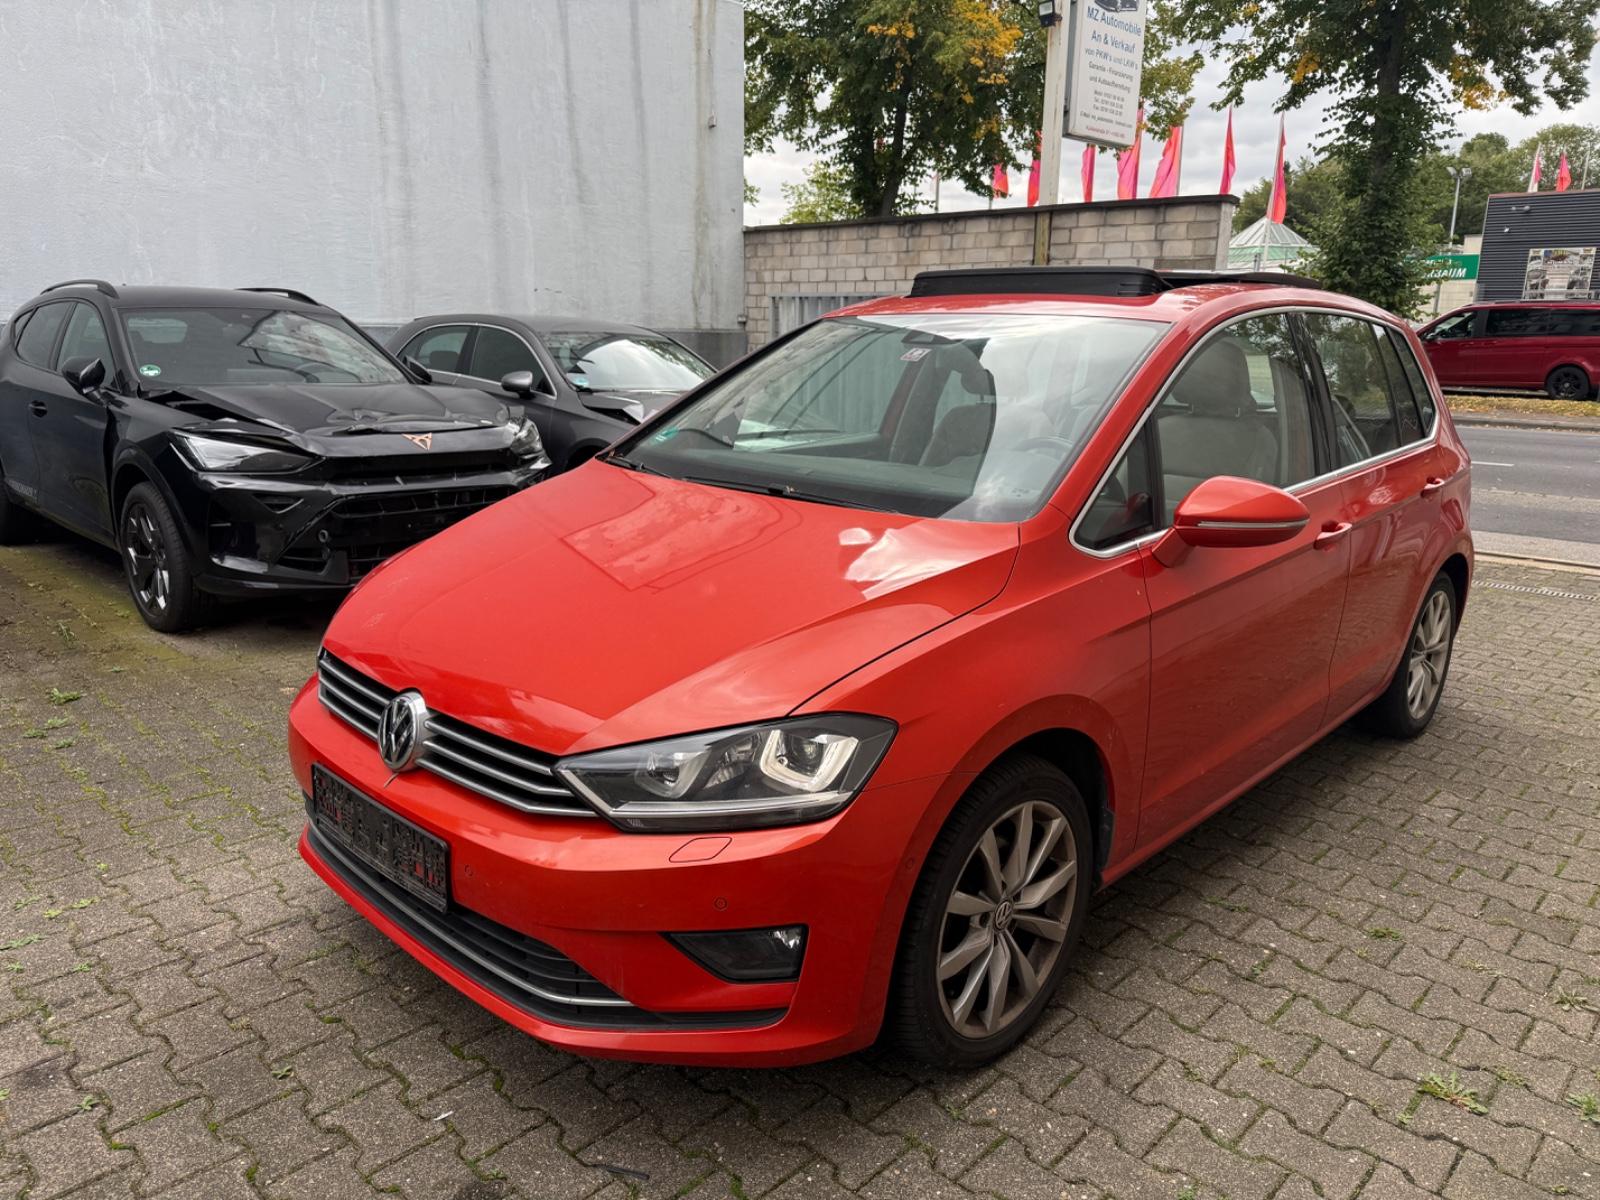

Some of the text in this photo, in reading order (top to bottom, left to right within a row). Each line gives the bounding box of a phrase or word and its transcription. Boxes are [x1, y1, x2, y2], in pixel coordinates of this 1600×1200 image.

[1087, 6, 1141, 37] MZ Automobile
[1091, 30, 1136, 54] An & Verkauf
